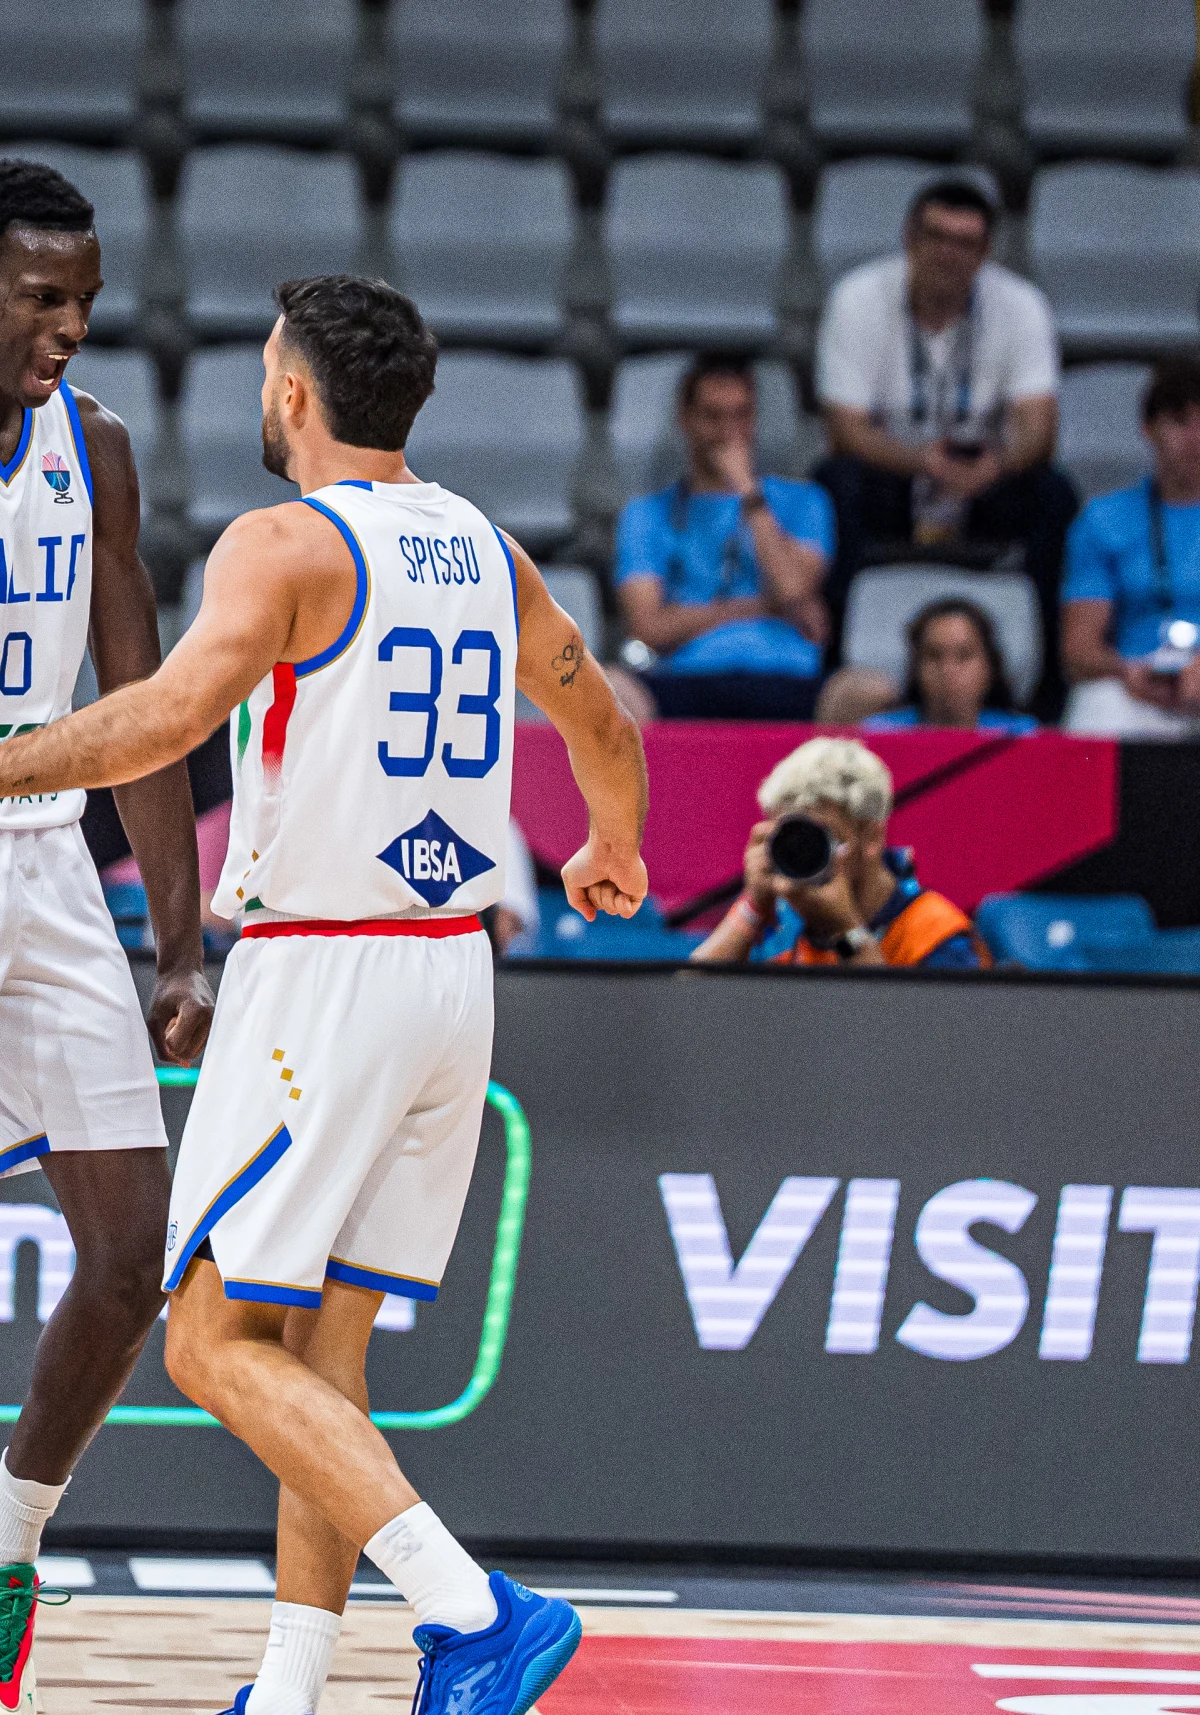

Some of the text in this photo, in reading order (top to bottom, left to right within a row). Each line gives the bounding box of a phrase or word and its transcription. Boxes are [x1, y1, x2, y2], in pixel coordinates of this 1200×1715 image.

[399, 535, 482, 586] SPISSU
[378, 626, 502, 779] 33
[400, 838, 463, 883] IBSA
[658, 1173, 1200, 1365] VISIT
